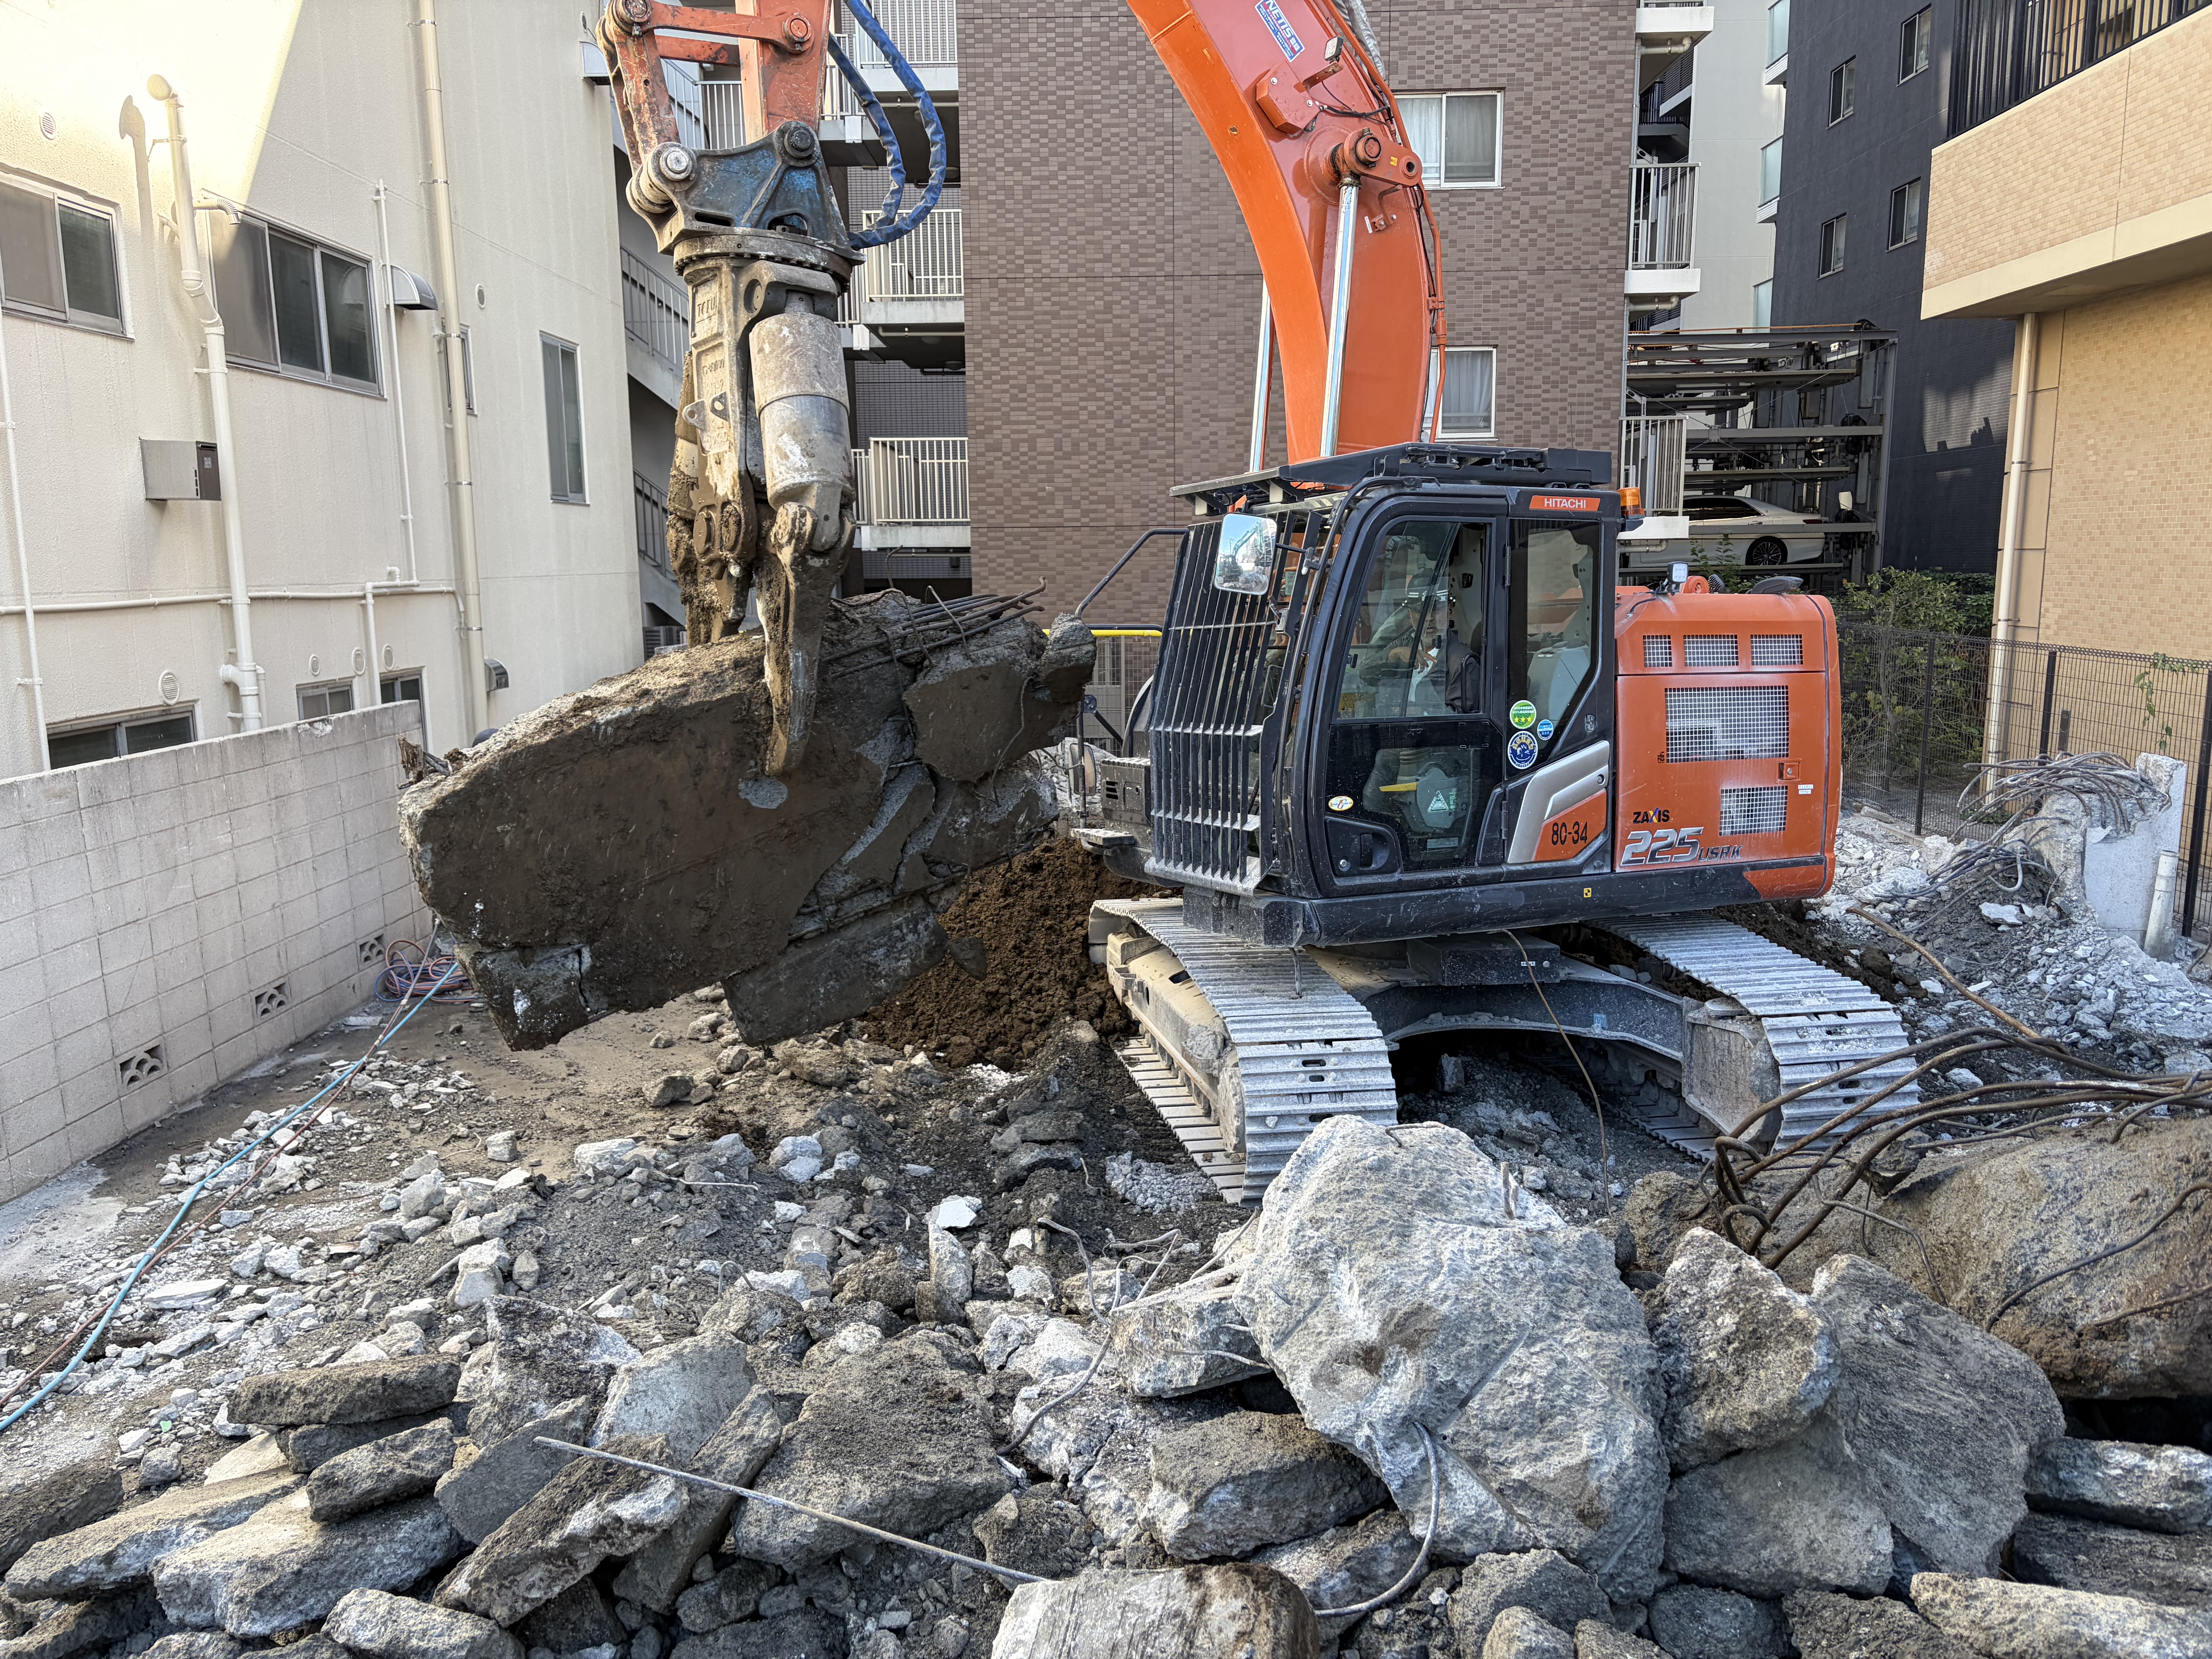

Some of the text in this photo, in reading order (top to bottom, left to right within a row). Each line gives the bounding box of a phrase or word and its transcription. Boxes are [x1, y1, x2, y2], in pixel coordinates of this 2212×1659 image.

[1265, 0, 1294, 38] NETIS
[1544, 498, 1586, 508] HITACHI
[1633, 807, 1670, 824] ZAXIS
[1552, 821, 1587, 845] 80-34
[1620, 827, 1743, 866] 225 USRK
